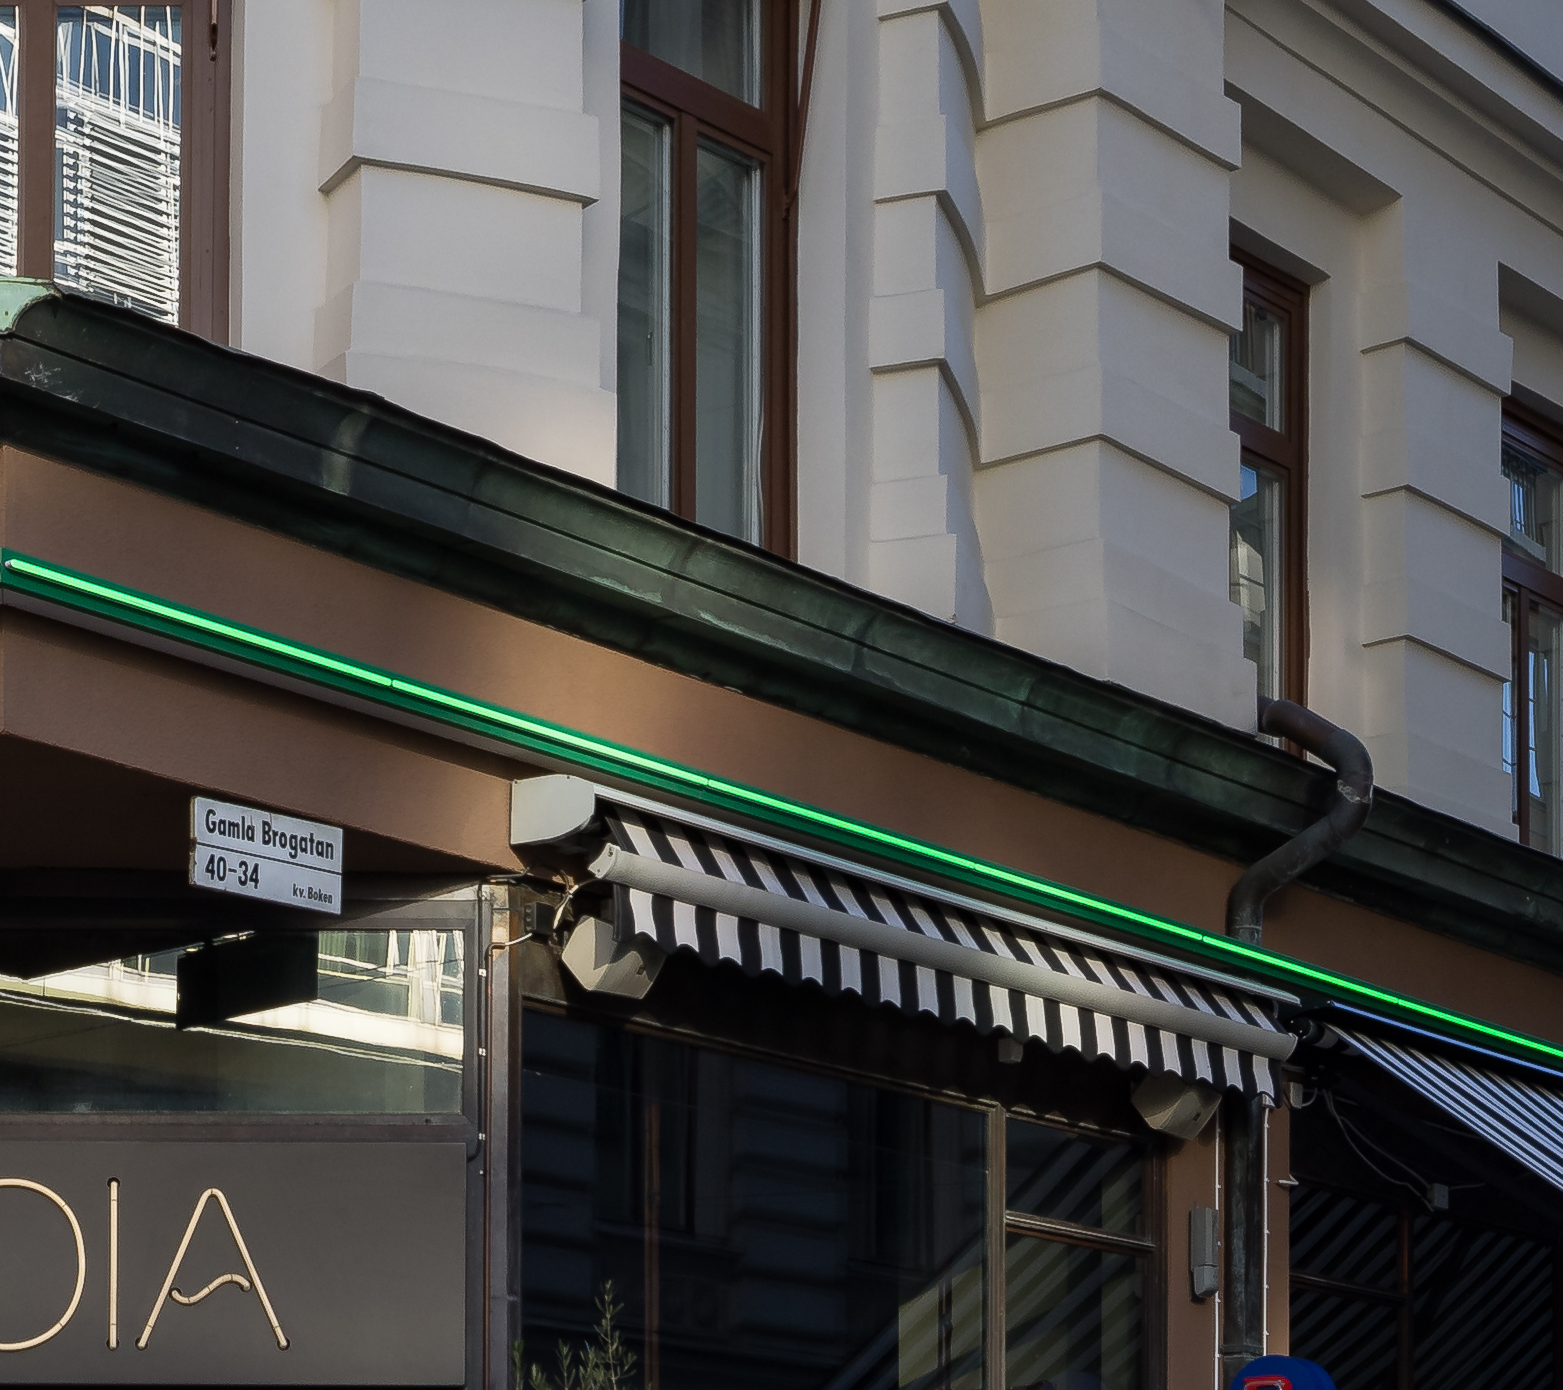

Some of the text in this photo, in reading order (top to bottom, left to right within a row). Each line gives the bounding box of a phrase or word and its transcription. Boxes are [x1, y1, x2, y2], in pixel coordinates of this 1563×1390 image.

[205, 808, 334, 860] Gamla Brogatan
[204, 853, 260, 890] 40-34
[292, 883, 333, 905] kv. Boken
